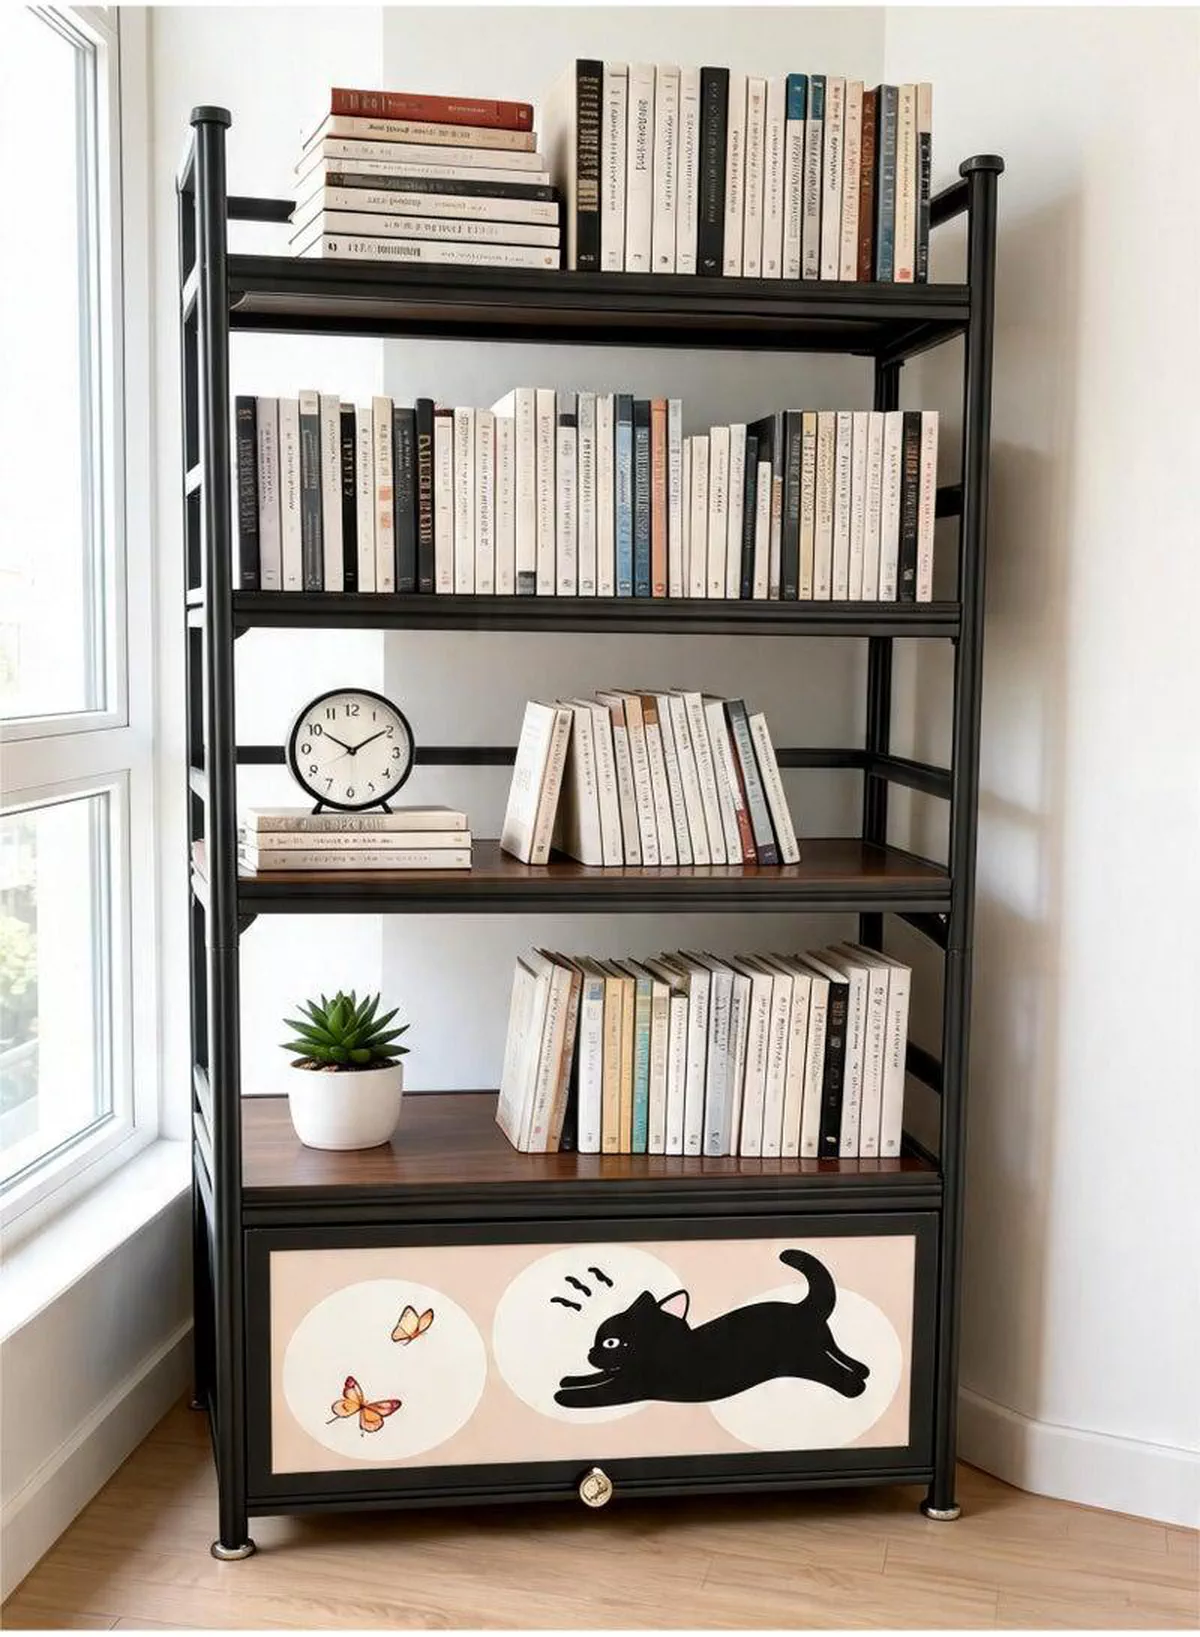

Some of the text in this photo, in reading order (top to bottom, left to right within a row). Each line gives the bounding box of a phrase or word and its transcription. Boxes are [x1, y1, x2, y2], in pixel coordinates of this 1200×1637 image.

[326, 708, 336, 720] 11
[345, 704, 360, 717] 12
[309, 723, 323, 736] 10
[386, 725, 394, 739] 2
[392, 747, 401, 759] 3
